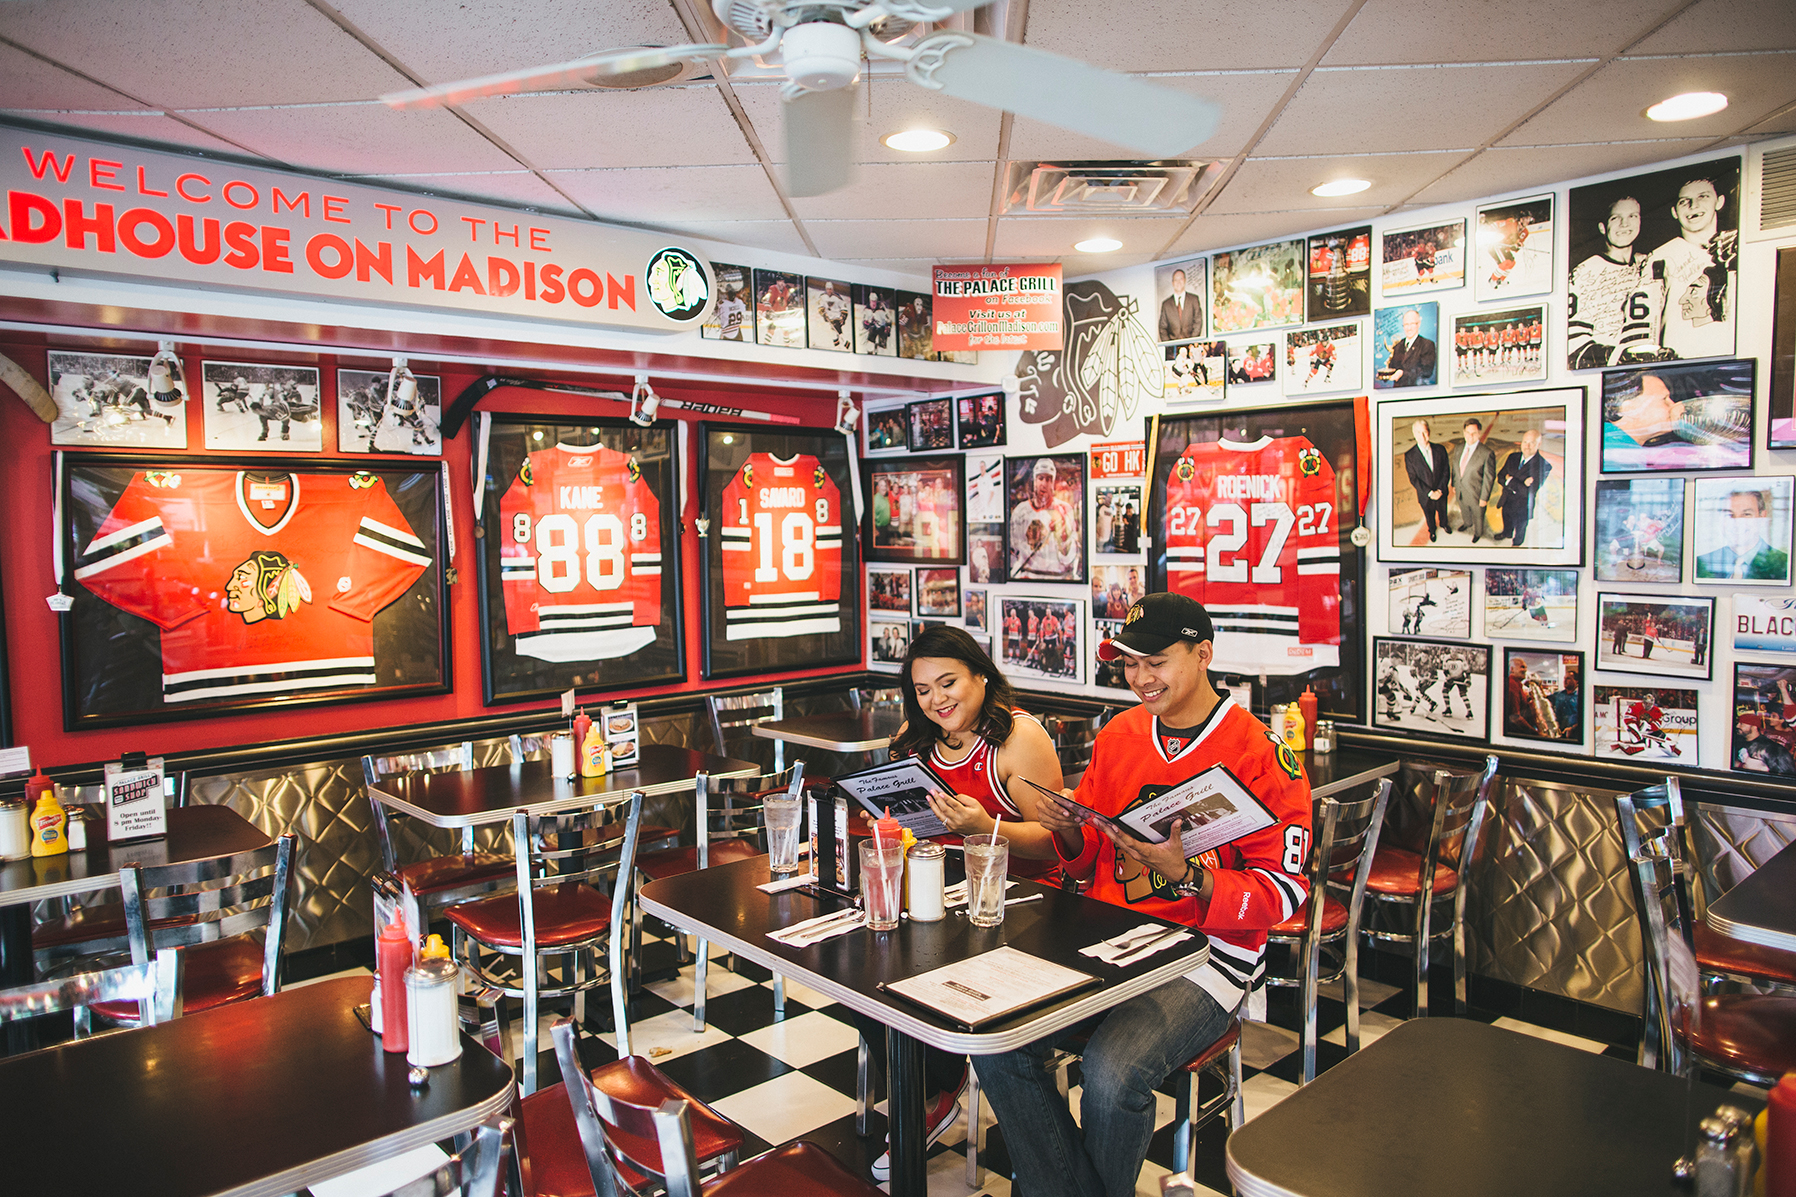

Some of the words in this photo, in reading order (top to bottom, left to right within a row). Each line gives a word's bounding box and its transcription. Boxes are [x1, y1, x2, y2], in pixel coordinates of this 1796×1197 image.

[20, 146, 352, 225] WELCOME
[374, 202, 439, 236] TO
[461, 216, 552, 252] THE
[0, 190, 294, 274] DHOUSE
[304, 232, 394, 287] ON
[405, 242, 637, 313] MADISON
[935, 269, 971, 279] Become
[981, 267, 998, 279] fan
[999, 266, 1010, 278] of
[935, 280, 962, 297] THE
[963, 278, 1018, 297] PALACE
[1019, 276, 1059, 294] GRILL
[985, 296, 999, 304] on
[1001, 294, 1053, 304] Facebook
[968, 310, 995, 319] Visit
[997, 311, 1011, 319] us
[1013, 309, 1026, 319] at
[937, 320, 1059, 335] PalaceGrillonMadison.com
[968, 334, 983, 346] for
[984, 334, 1000, 345] the
[1001, 333, 1027, 344] latest
[681, 400, 743, 417] BAUER
[1102, 451, 1118, 473] GO
[559, 486, 603, 509] KANE
[1217, 474, 1282, 499] ROENICK
[759, 487, 806, 509] SAVARD
[738, 498, 749, 525] 1
[815, 498, 829, 524] 8
[1170, 506, 1201, 536] 27
[1296, 501, 1333, 537] 27
[513, 512, 532, 543] 8
[630, 512, 647, 541] 8
[535, 513, 625, 594] 88
[754, 512, 815, 582] 18
[1206, 502, 1296, 584] 27
[1737, 614, 1796, 636] BLAC
[1662, 715, 1697, 726] Group
[113, 776, 157, 796] SANDWICH
[856, 783, 891, 794] Palace
[892, 777, 916, 788] Grill
[872, 774, 898, 783] Famous
[125, 788, 147, 801] SHOP
[1140, 800, 1182, 823] Palace
[1184, 783, 1214, 802] Grill
[1145, 801, 1160, 810] The
[1161, 786, 1194, 802] Famous
[120, 811, 138, 819] Open
[124, 822, 152, 831] Friday!!
[1237, 891, 1252, 921] Reebok
